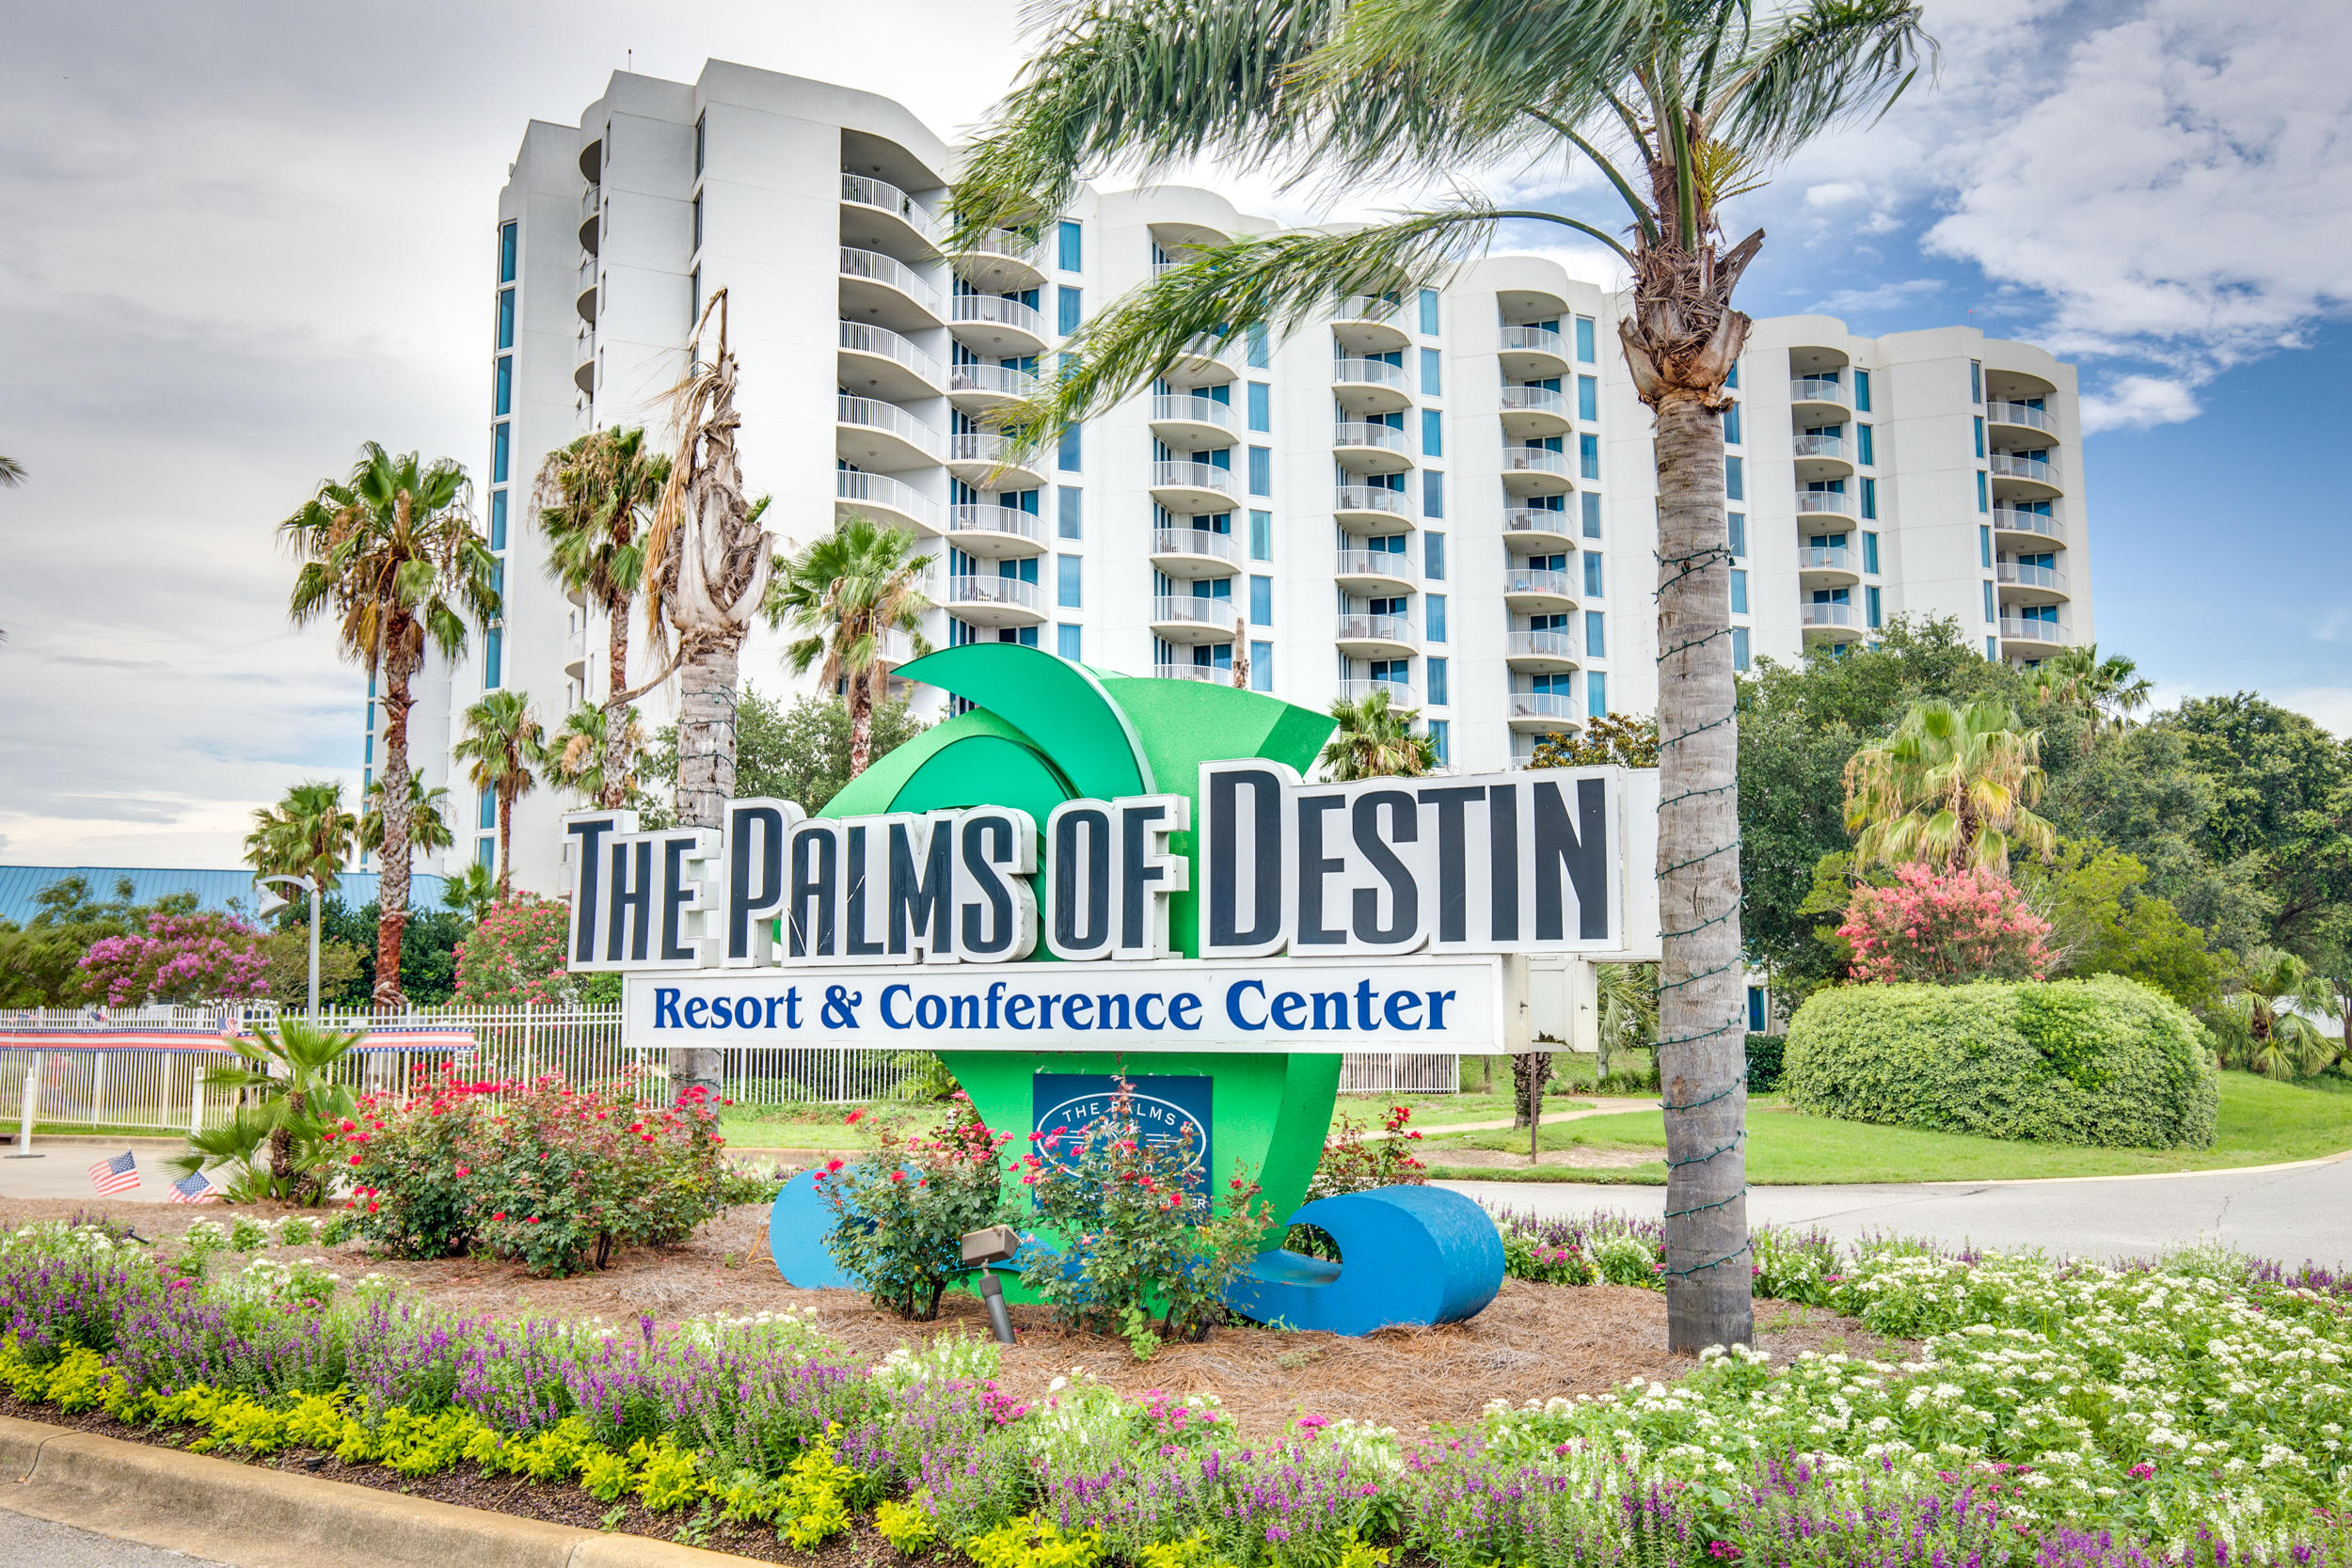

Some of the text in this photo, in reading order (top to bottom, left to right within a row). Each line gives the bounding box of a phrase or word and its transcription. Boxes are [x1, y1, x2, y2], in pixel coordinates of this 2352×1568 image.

[568, 769, 1609, 962] THE PALMS OF DESTIN
[654, 979, 1456, 1031] Resort & Conference Center
[1062, 1102, 1100, 1122] THE
